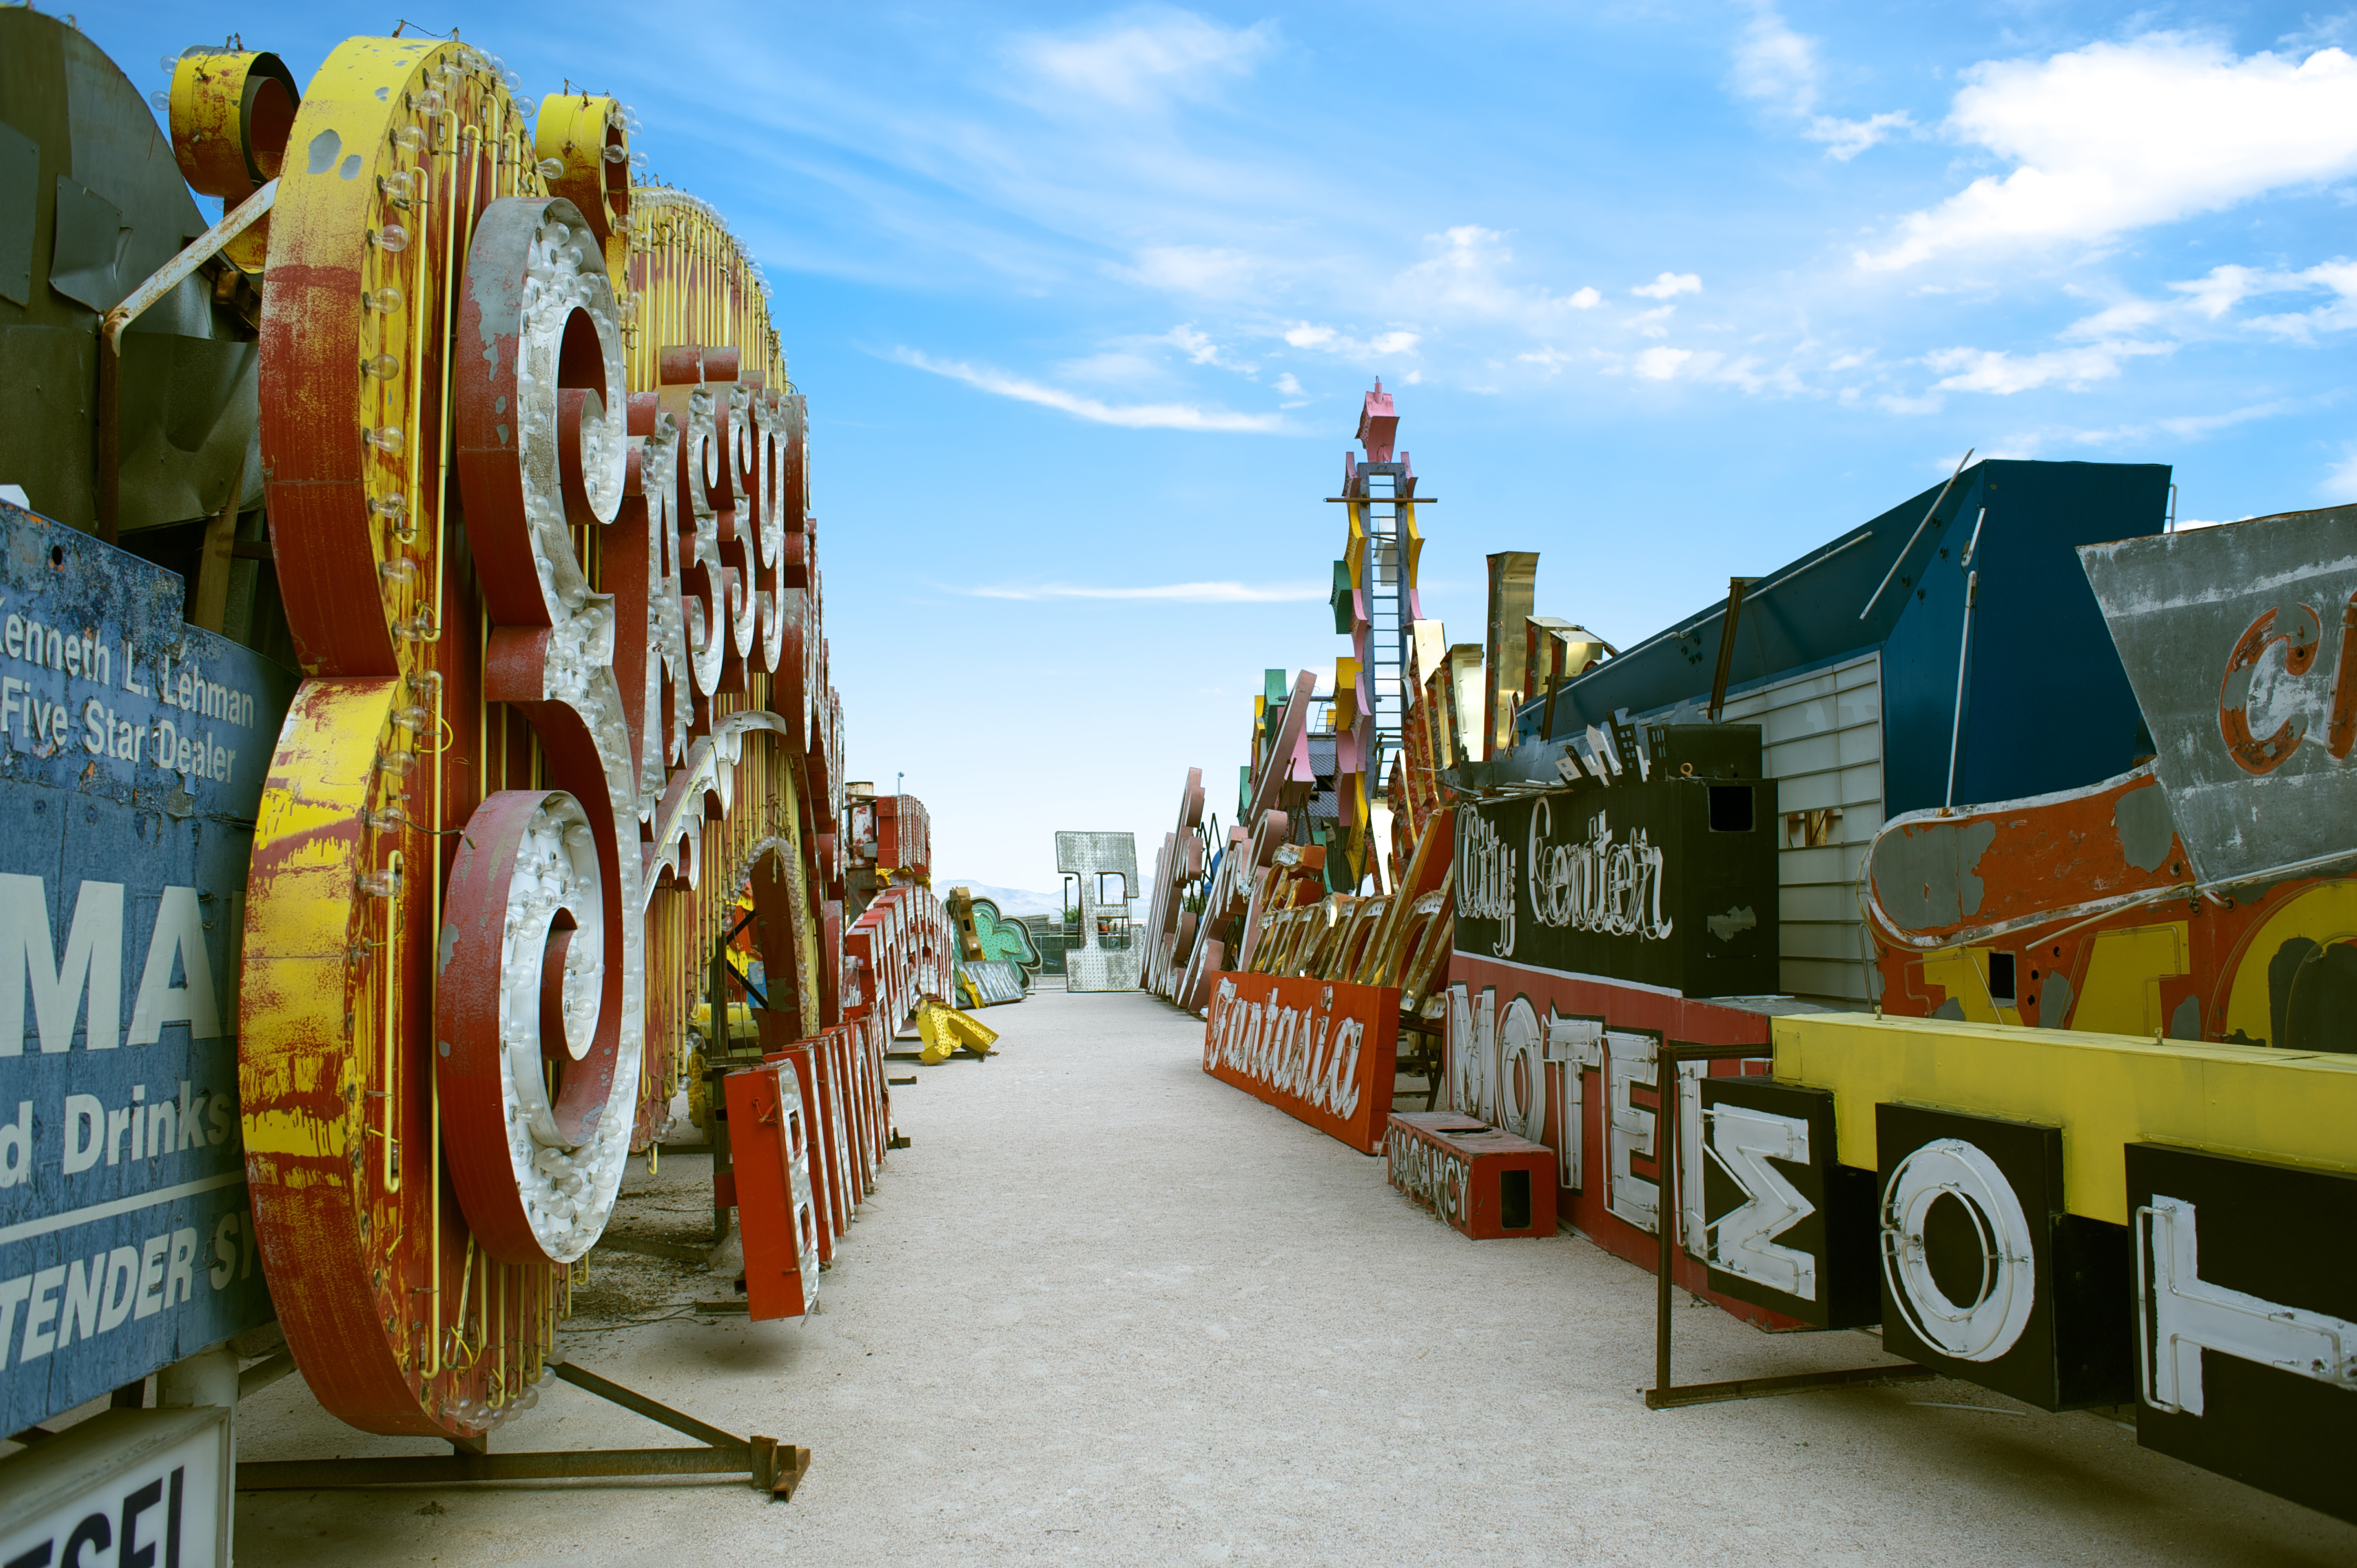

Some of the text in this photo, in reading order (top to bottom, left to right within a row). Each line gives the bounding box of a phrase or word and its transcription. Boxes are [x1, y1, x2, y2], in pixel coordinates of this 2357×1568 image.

[0, 597, 254, 729] enneth L. Lehman
[1, 675, 236, 783] Five Star Dealer
[1454, 802, 1516, 958] City
[1528, 796, 1673, 941] Center
[0, 872, 238, 1056] MA
[1387, 1125, 1470, 1222] VACANCY
[210, 1209, 264, 1291] SY
